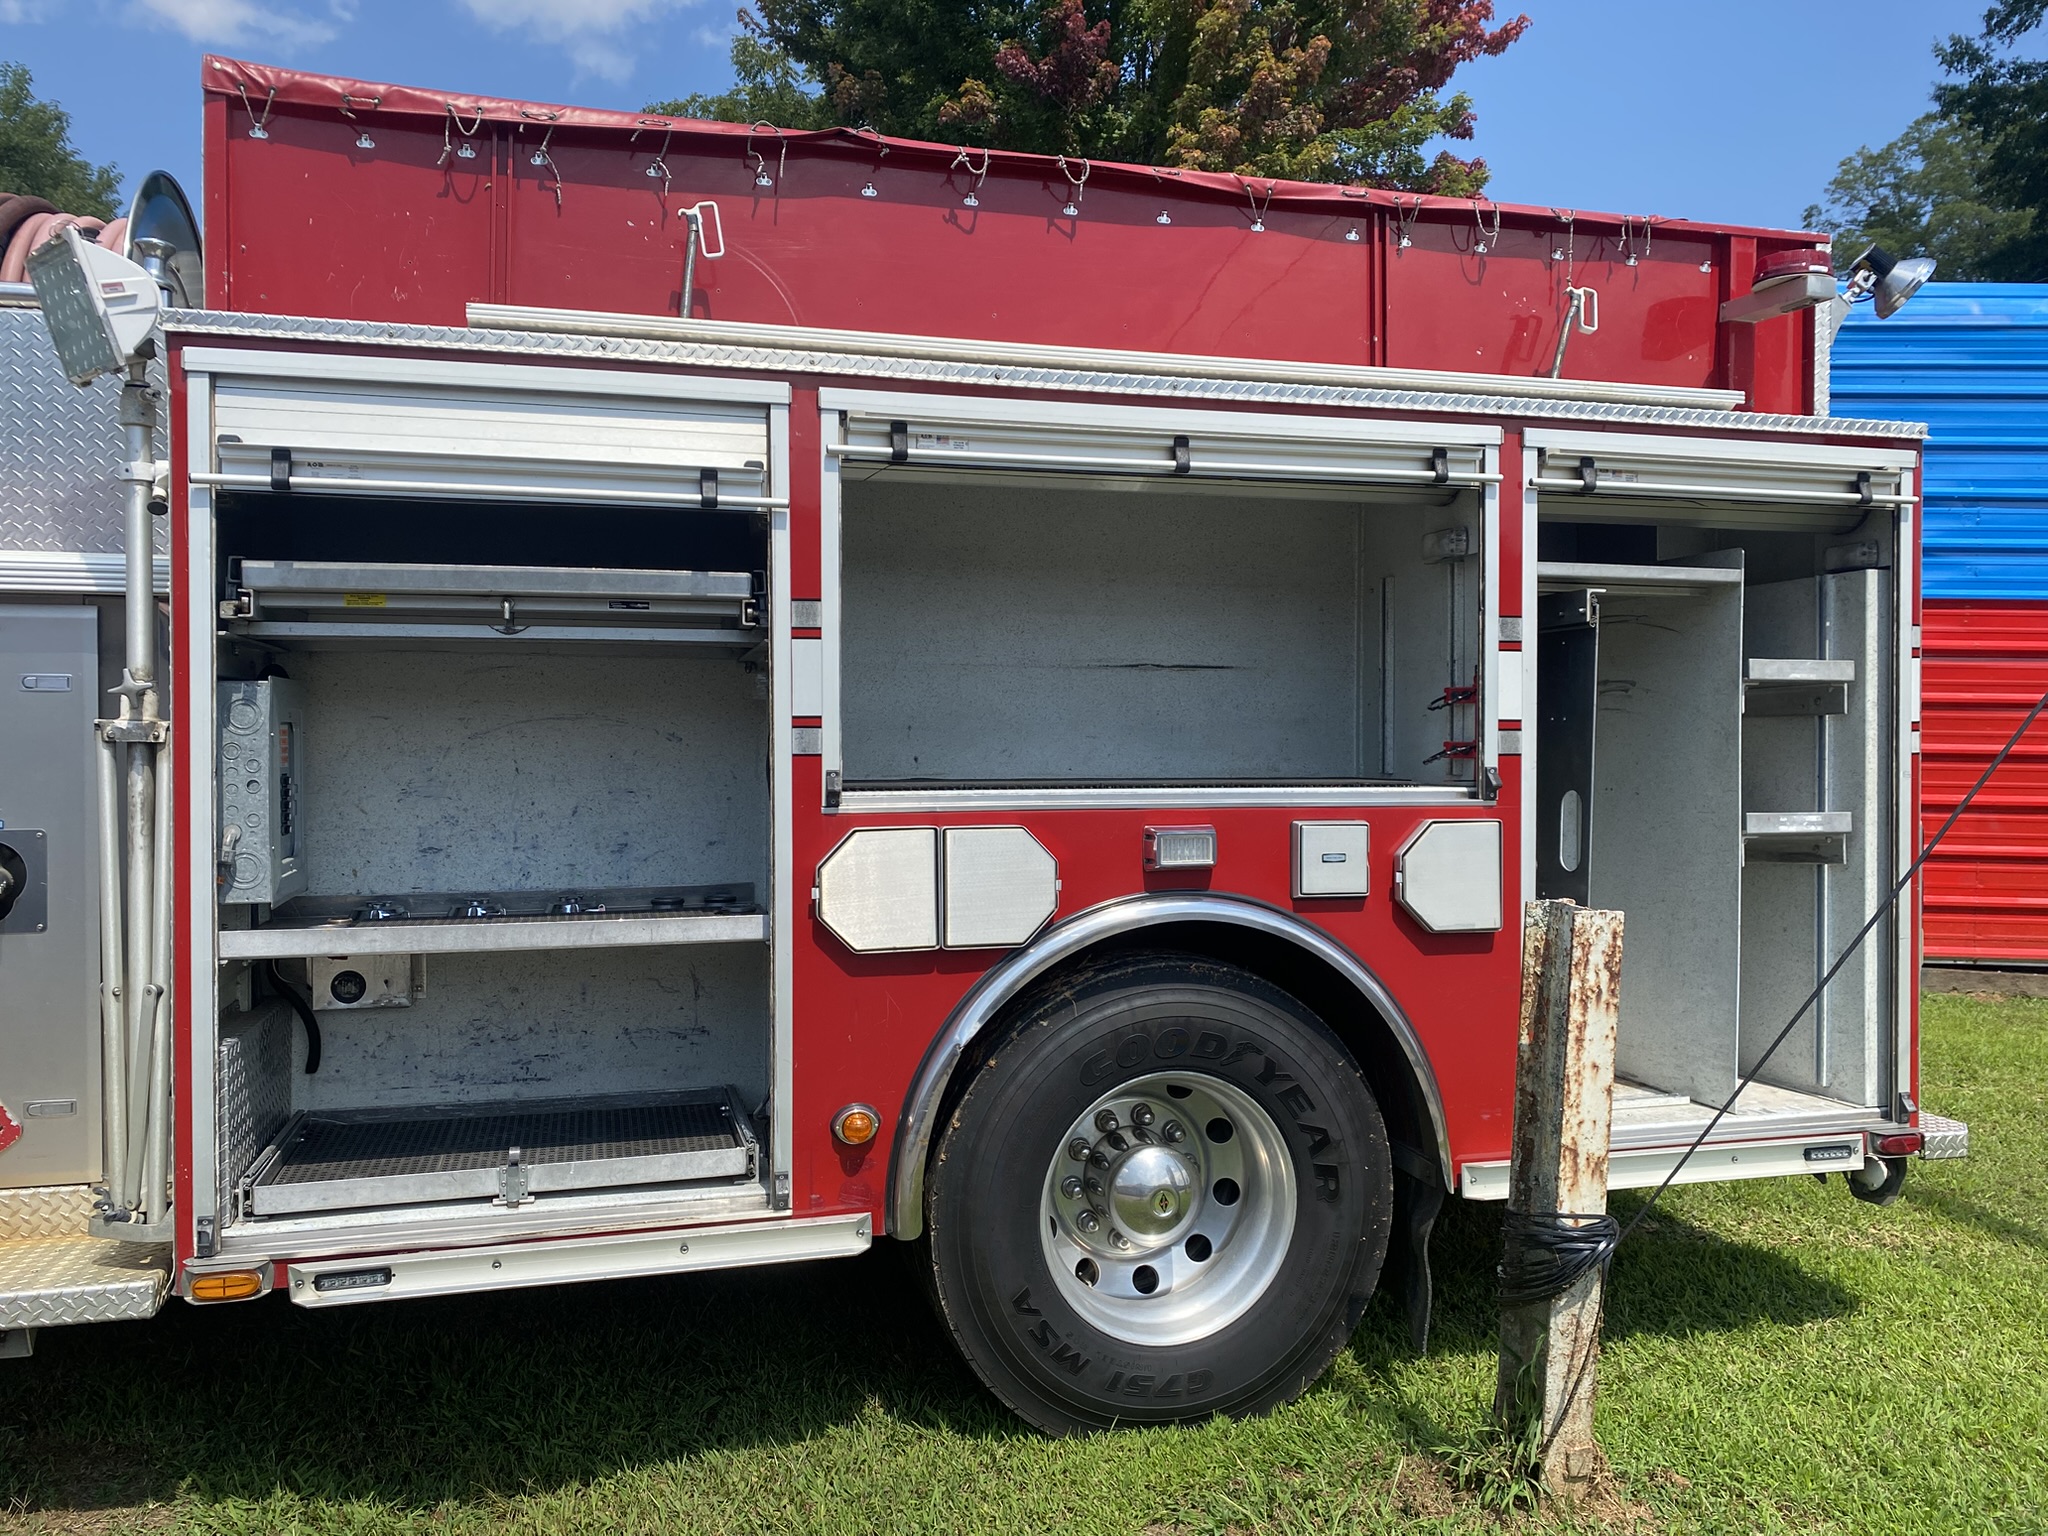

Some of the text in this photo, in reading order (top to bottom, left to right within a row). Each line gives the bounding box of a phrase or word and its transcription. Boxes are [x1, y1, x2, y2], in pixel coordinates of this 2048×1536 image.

[1079, 1026, 1342, 1206] GOODYEAR
[1010, 1285, 1215, 1399] G751 MSA
